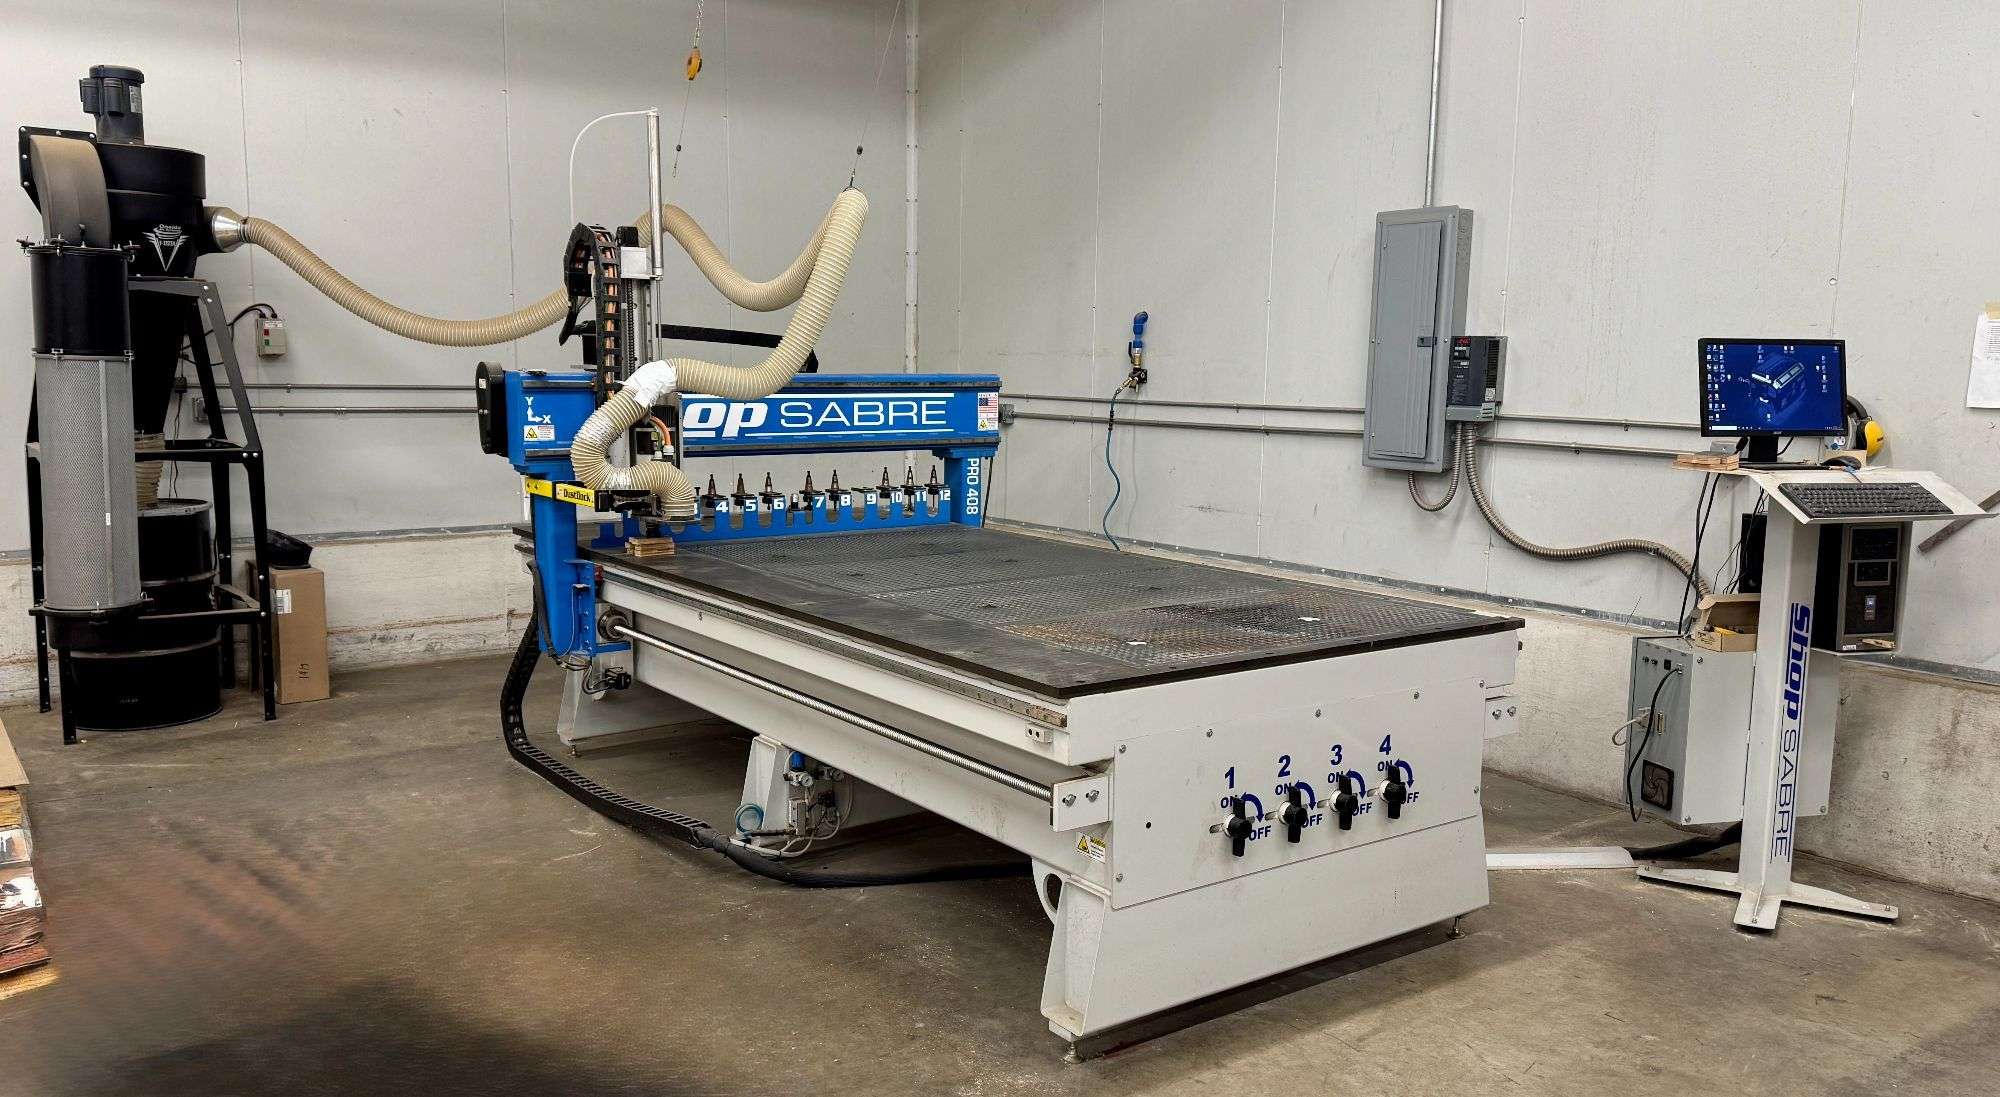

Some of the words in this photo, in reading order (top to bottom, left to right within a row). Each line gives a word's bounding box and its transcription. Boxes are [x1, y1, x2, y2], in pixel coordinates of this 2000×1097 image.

[525, 397, 533, 406] Y
[543, 415, 551, 424] X
[683, 402, 768, 438] op
[780, 400, 947, 428] SABRE
[967, 457, 979, 485] PRO
[715, 501, 729, 513] 4
[745, 499, 757, 512] 5
[773, 497, 785, 510] 6
[814, 496, 825, 508] 7
[840, 494, 851, 506] 8
[866, 493, 877, 505] 9
[890, 491, 903, 504] 10
[915, 489, 927, 502] 11
[939, 488, 951, 501] 12
[967, 489, 979, 515] 408
[1784, 602, 1811, 721] Shop
[1330, 744, 1343, 766] 3
[1379, 734, 1392, 756] 4
[1278, 754, 1291, 777] 2
[1224, 766, 1235, 789] 1
[1401, 792, 1420, 805] FF
[1774, 729, 1797, 858] SABRE
[1248, 825, 1272, 842] OFF
